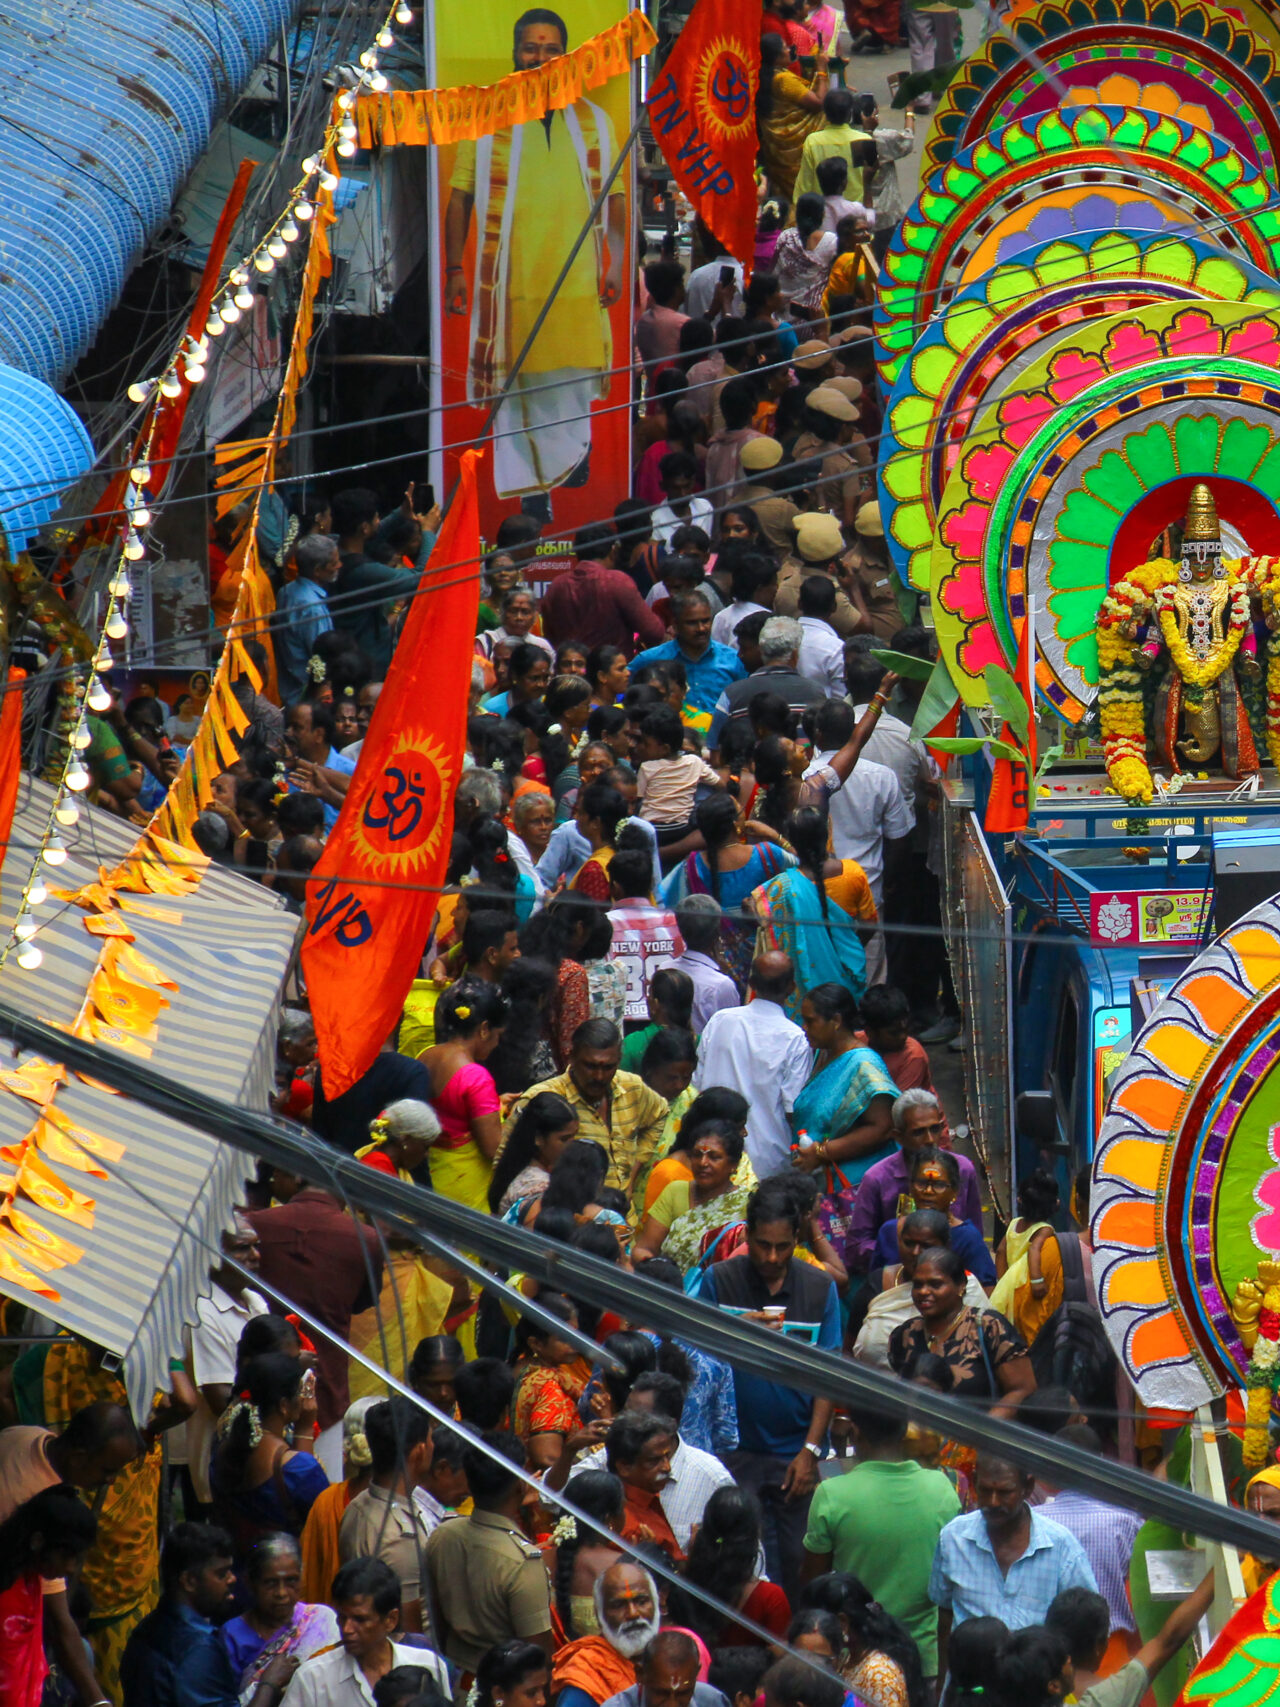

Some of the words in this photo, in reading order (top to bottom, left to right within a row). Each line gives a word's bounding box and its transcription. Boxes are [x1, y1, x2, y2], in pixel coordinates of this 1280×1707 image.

[647, 73, 690, 136] TN
[677, 127, 735, 197] VHP
[611, 941, 640, 954] NEW
[643, 940, 675, 953] YORK
